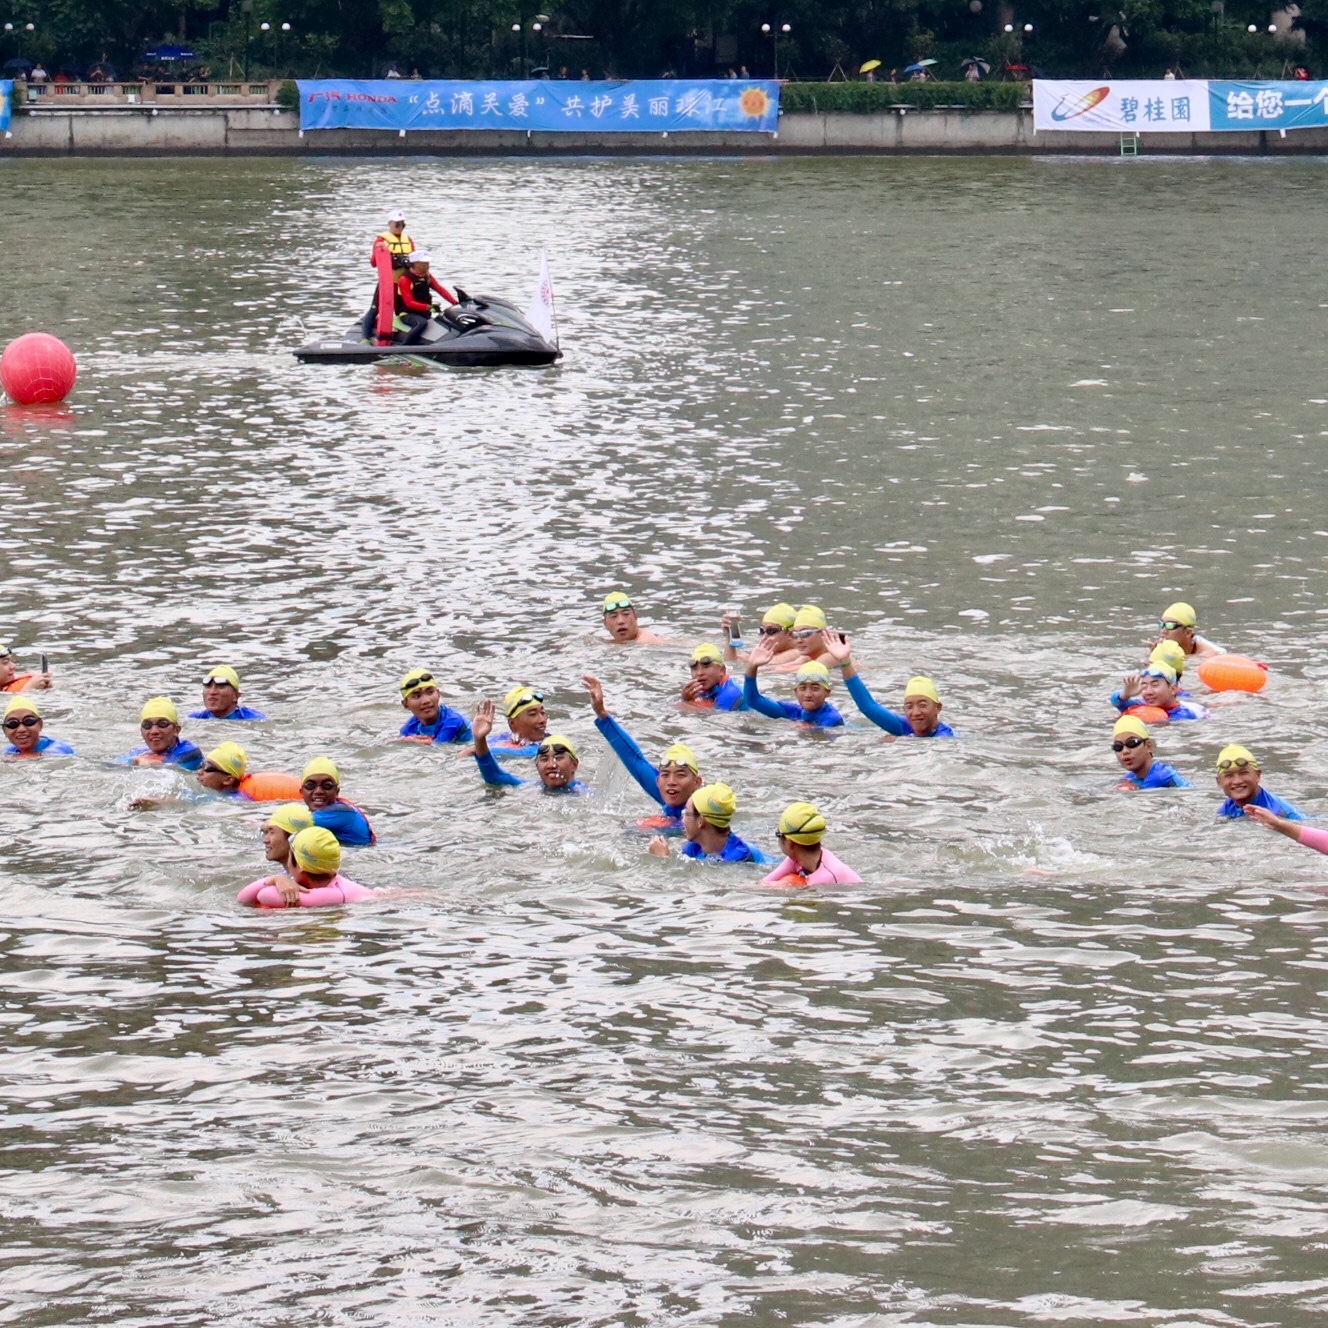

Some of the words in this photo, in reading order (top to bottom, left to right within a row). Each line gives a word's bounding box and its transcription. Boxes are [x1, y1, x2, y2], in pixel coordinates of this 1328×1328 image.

[346, 93, 398, 104] HONDA
[561, 93, 727, 118] 共护美丽珠江
[1120, 96, 1191, 123] 碧桂園
